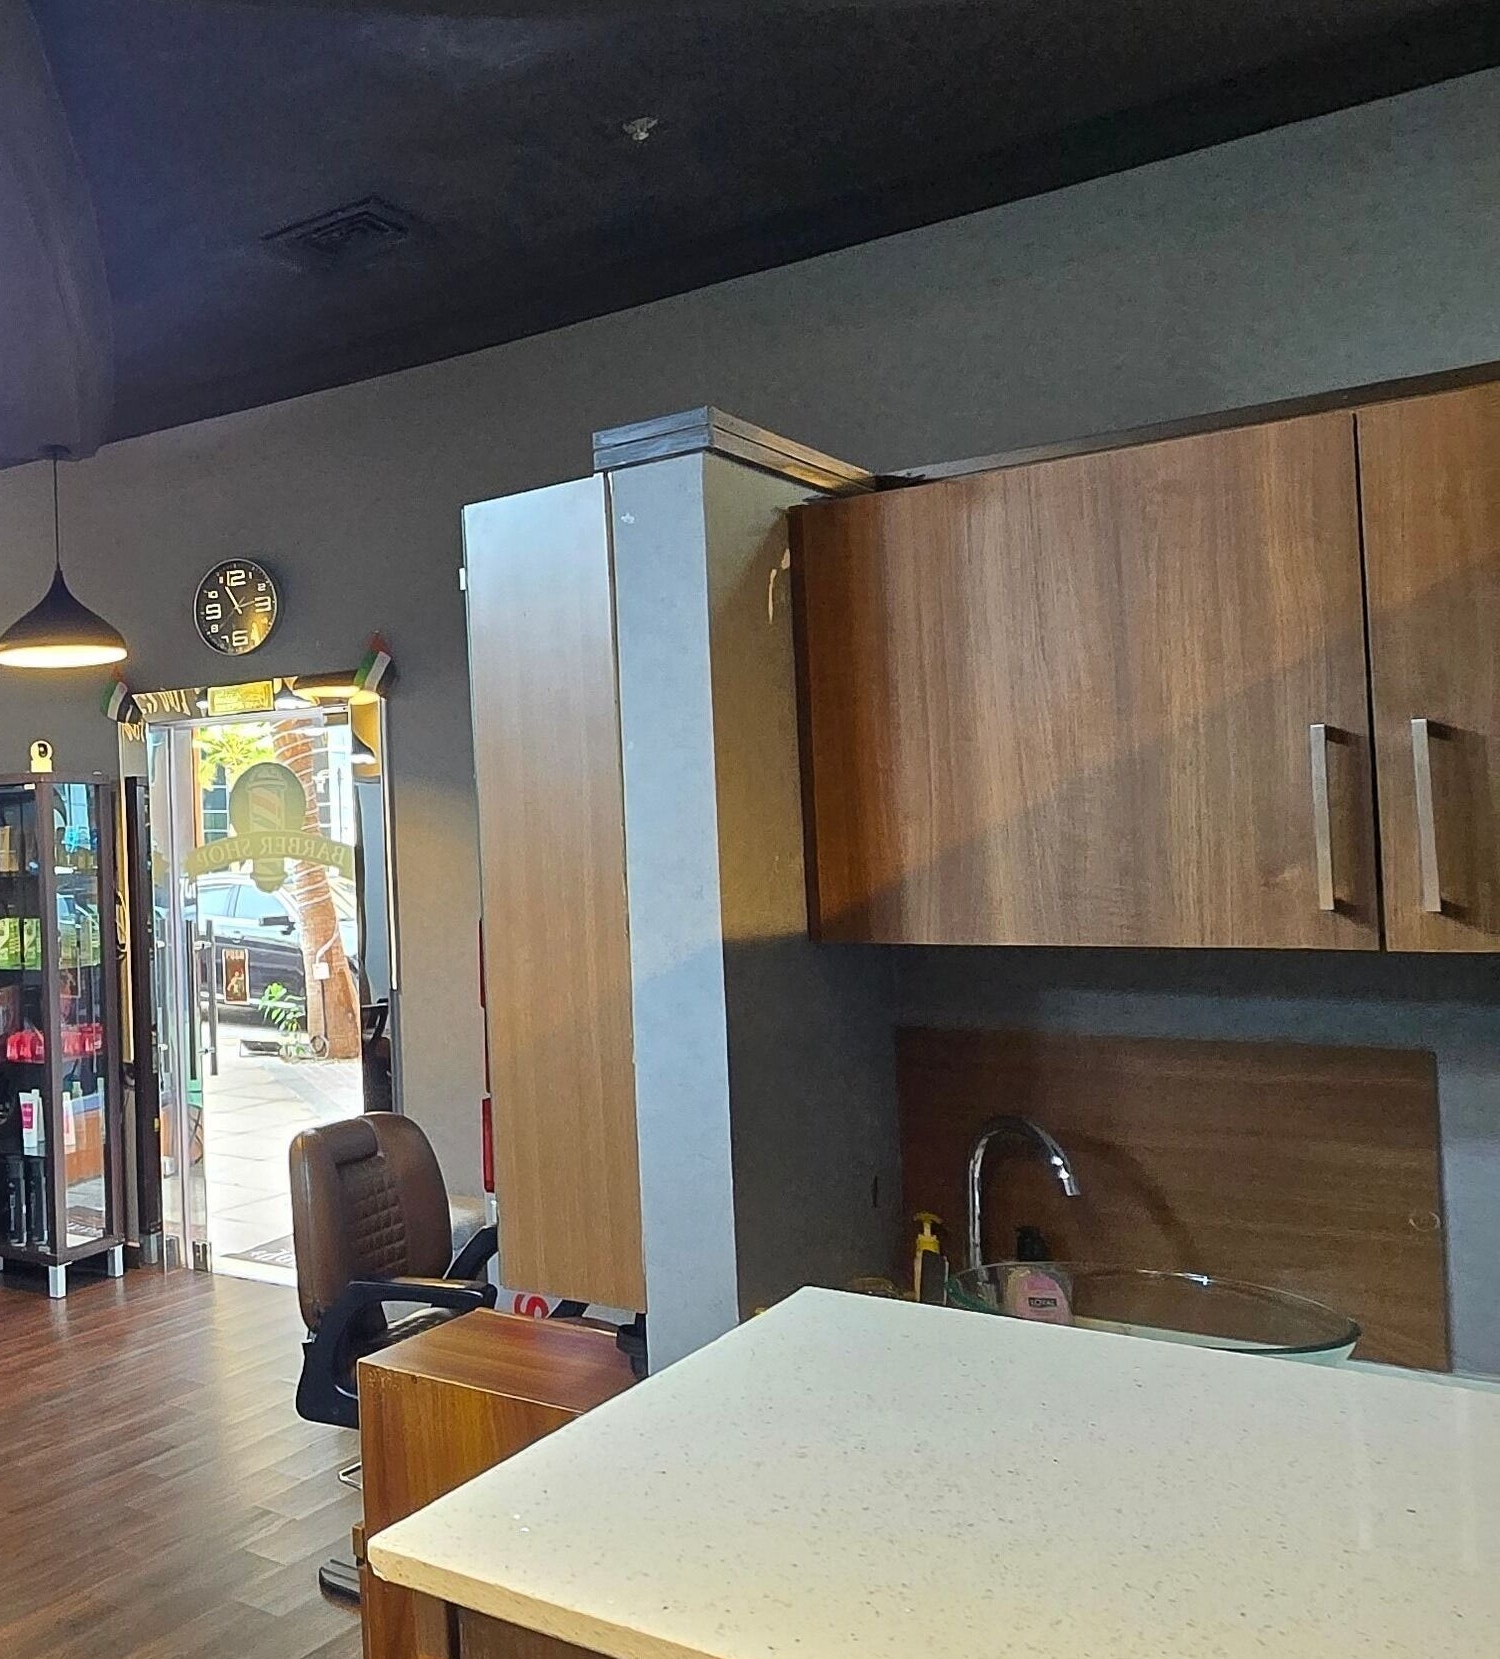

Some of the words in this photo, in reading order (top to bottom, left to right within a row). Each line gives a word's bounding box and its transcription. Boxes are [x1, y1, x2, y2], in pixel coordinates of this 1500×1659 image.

[226, 570, 246, 587] 12
[205, 603, 222, 620] 9
[254, 596, 272, 613] 3
[232, 629, 249, 647] 6
